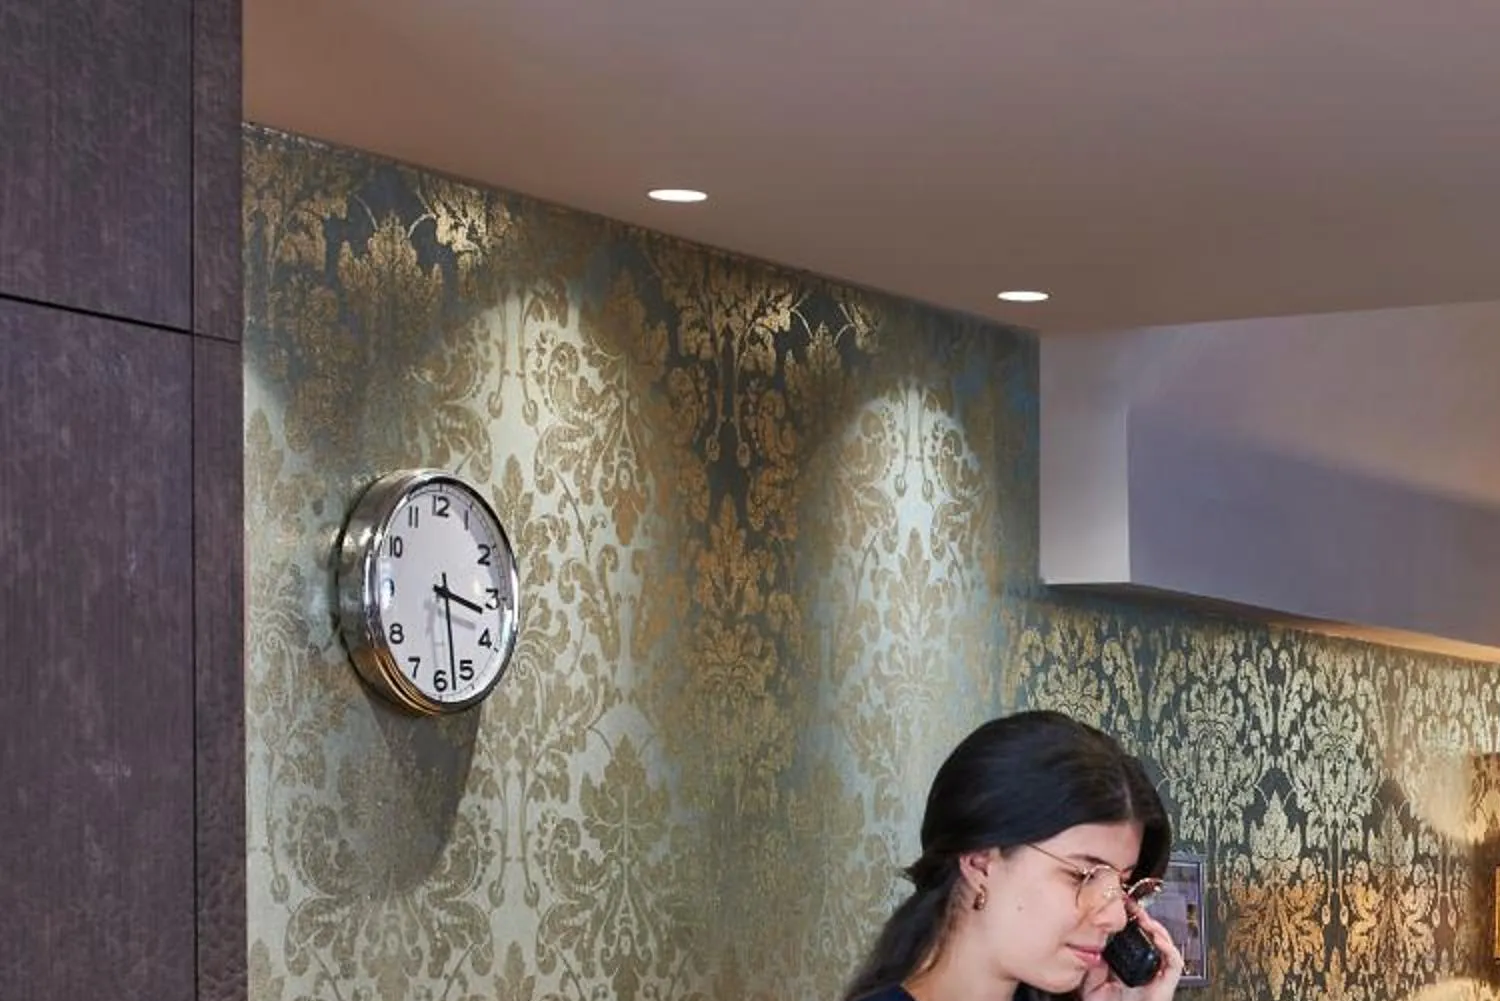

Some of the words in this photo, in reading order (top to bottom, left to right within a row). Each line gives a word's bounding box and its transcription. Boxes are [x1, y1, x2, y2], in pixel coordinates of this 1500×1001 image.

[432, 496, 450, 518] 12
[409, 507, 419, 529] 11
[464, 510, 469, 531] 1
[389, 536, 403, 558] 10
[477, 544, 491, 566] 2
[485, 588, 499, 609] 3
[389, 623, 404, 644] 8
[478, 628, 492, 648] 4
[408, 657, 421, 678] 7
[459, 660, 474, 681] 5
[433, 670, 448, 692] 6
